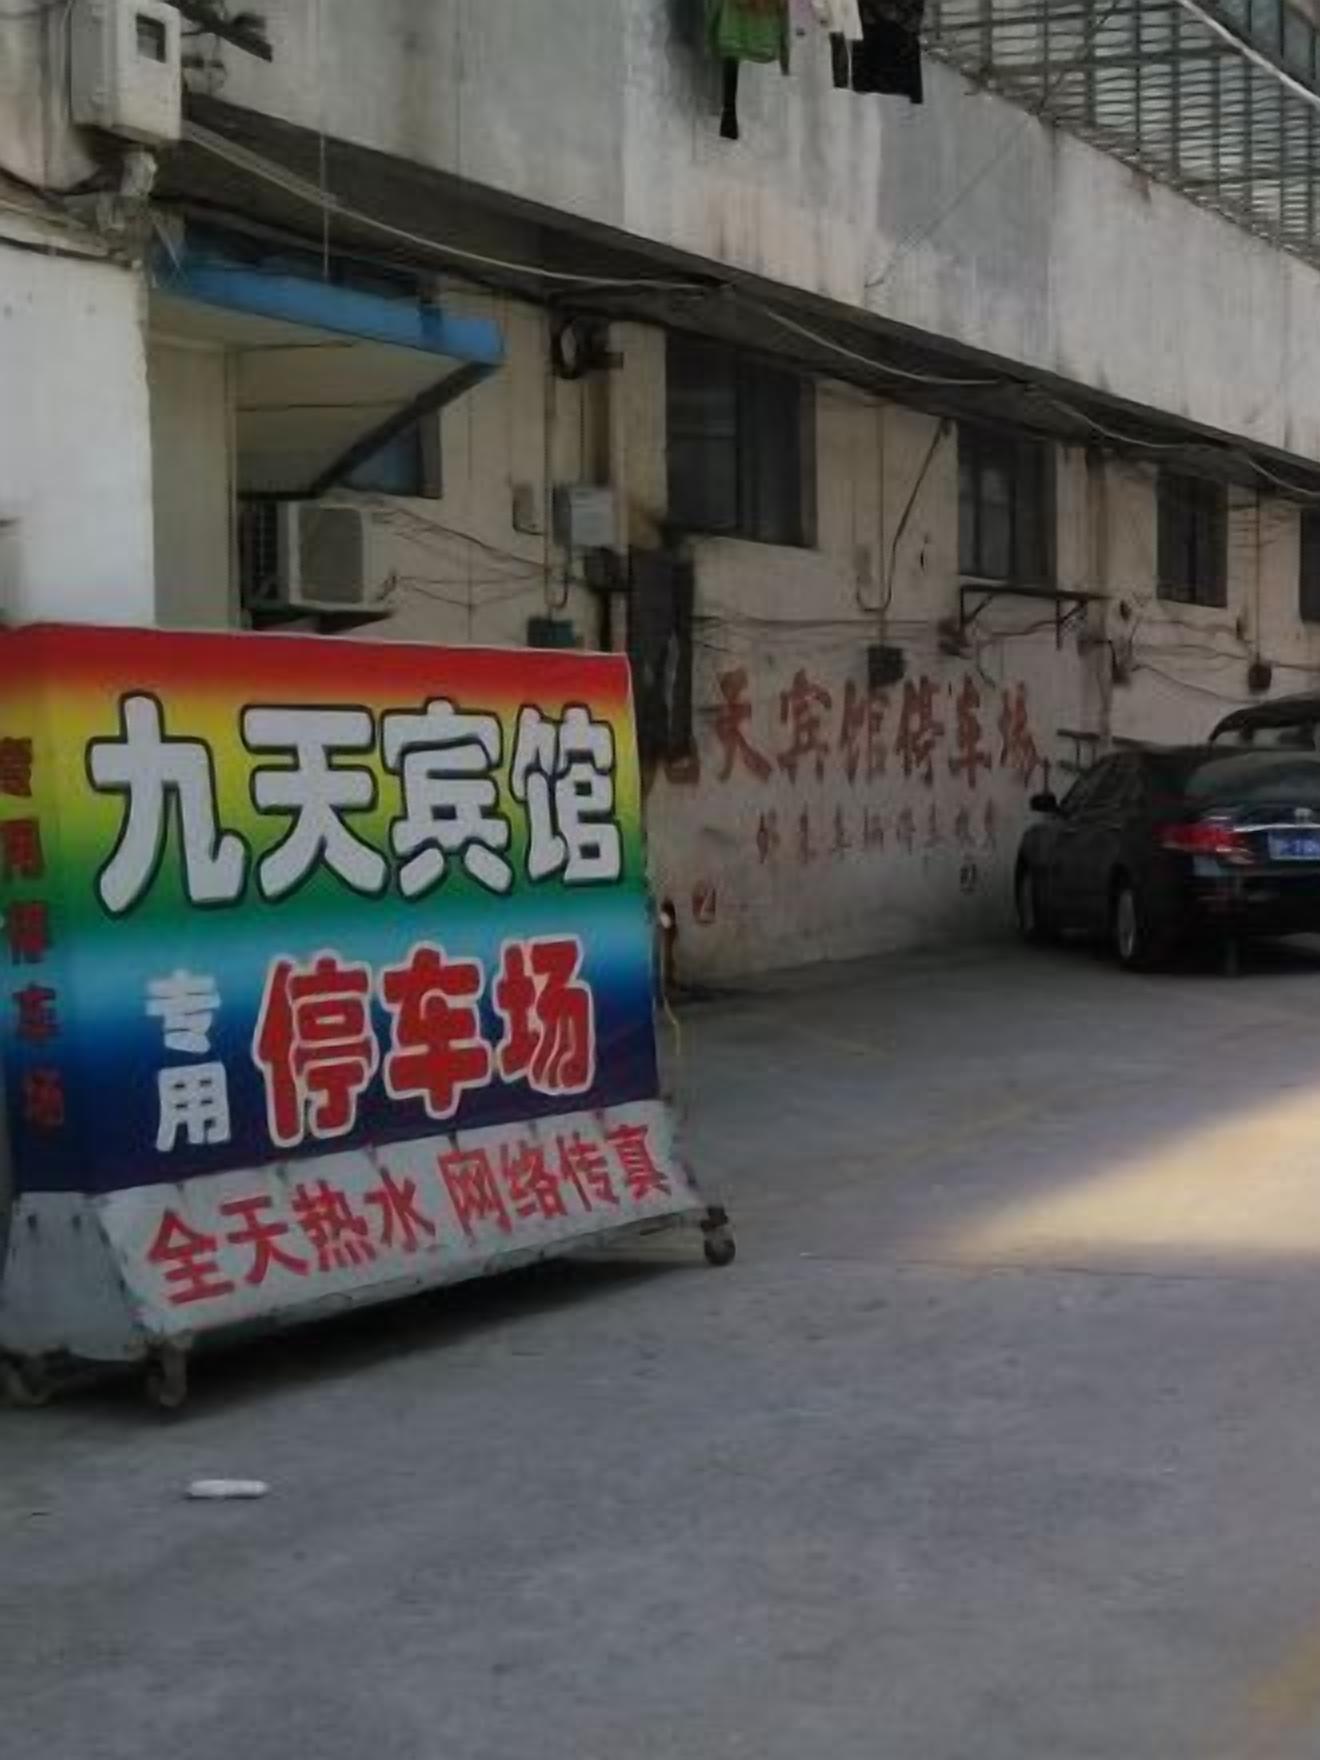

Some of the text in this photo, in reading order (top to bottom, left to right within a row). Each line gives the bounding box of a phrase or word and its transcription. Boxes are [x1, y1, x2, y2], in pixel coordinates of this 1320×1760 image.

[86, 691, 623, 915] 九天宾馆
[664, 665, 1043, 789] 天宾馆停车场
[146, 970, 231, 1152] 专用
[254, 934, 594, 1146] 停车场
[147, 1122, 672, 1306] 全天热水 网络传真
